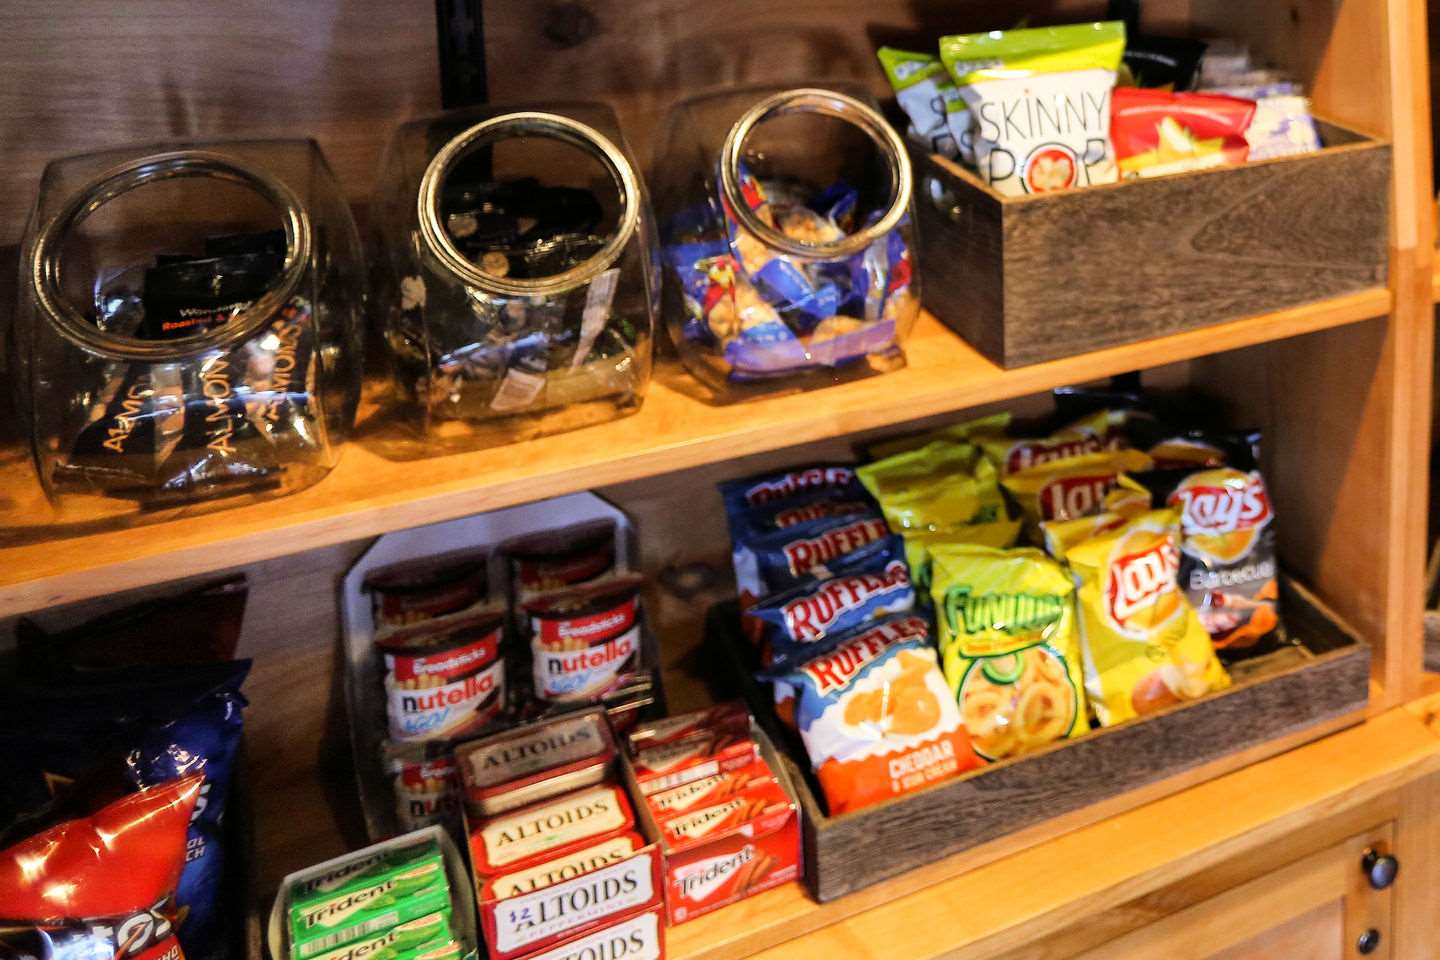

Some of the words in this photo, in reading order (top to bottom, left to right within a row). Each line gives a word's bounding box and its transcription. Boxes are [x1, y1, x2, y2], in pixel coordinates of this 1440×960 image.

[980, 90, 1107, 144] SKINNY
[989, 138, 1106, 193] POP
[547, 639, 632, 673] nutella
[801, 616, 930, 697] RUFFLES
[402, 672, 494, 713] nutella
[482, 724, 592, 770] ALTOIDS
[888, 738, 955, 780] CHEDDAR
[657, 772, 730, 810] Trident
[496, 801, 609, 847] ALTOIDS
[671, 796, 745, 839] Trident
[677, 845, 756, 896] Trident
[304, 879, 397, 929] Trident
[514, 868, 639, 933] ALTOIDS
[568, 928, 646, 960] TOIDS
